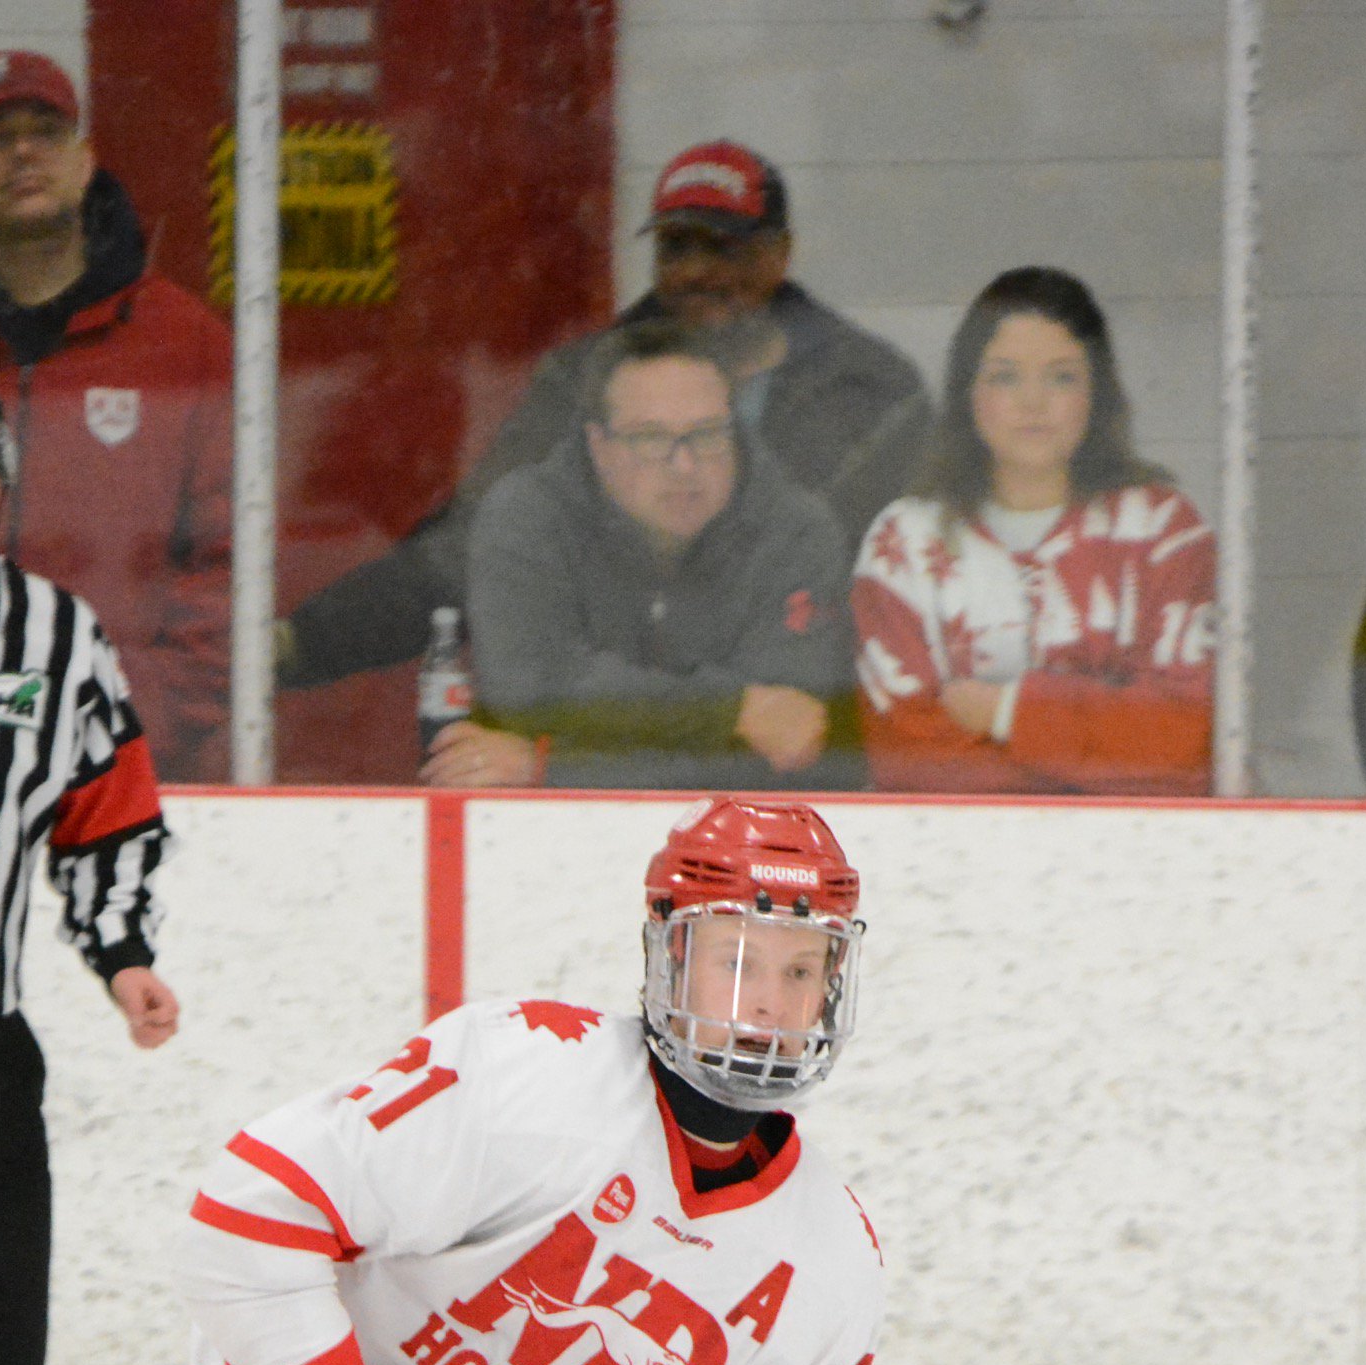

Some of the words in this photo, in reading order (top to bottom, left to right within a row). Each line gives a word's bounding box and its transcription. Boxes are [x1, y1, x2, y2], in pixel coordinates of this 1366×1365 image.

[750, 863, 818, 886] HOUNDS
[652, 1215, 714, 1252] BAUER
[724, 1260, 795, 1343] A
